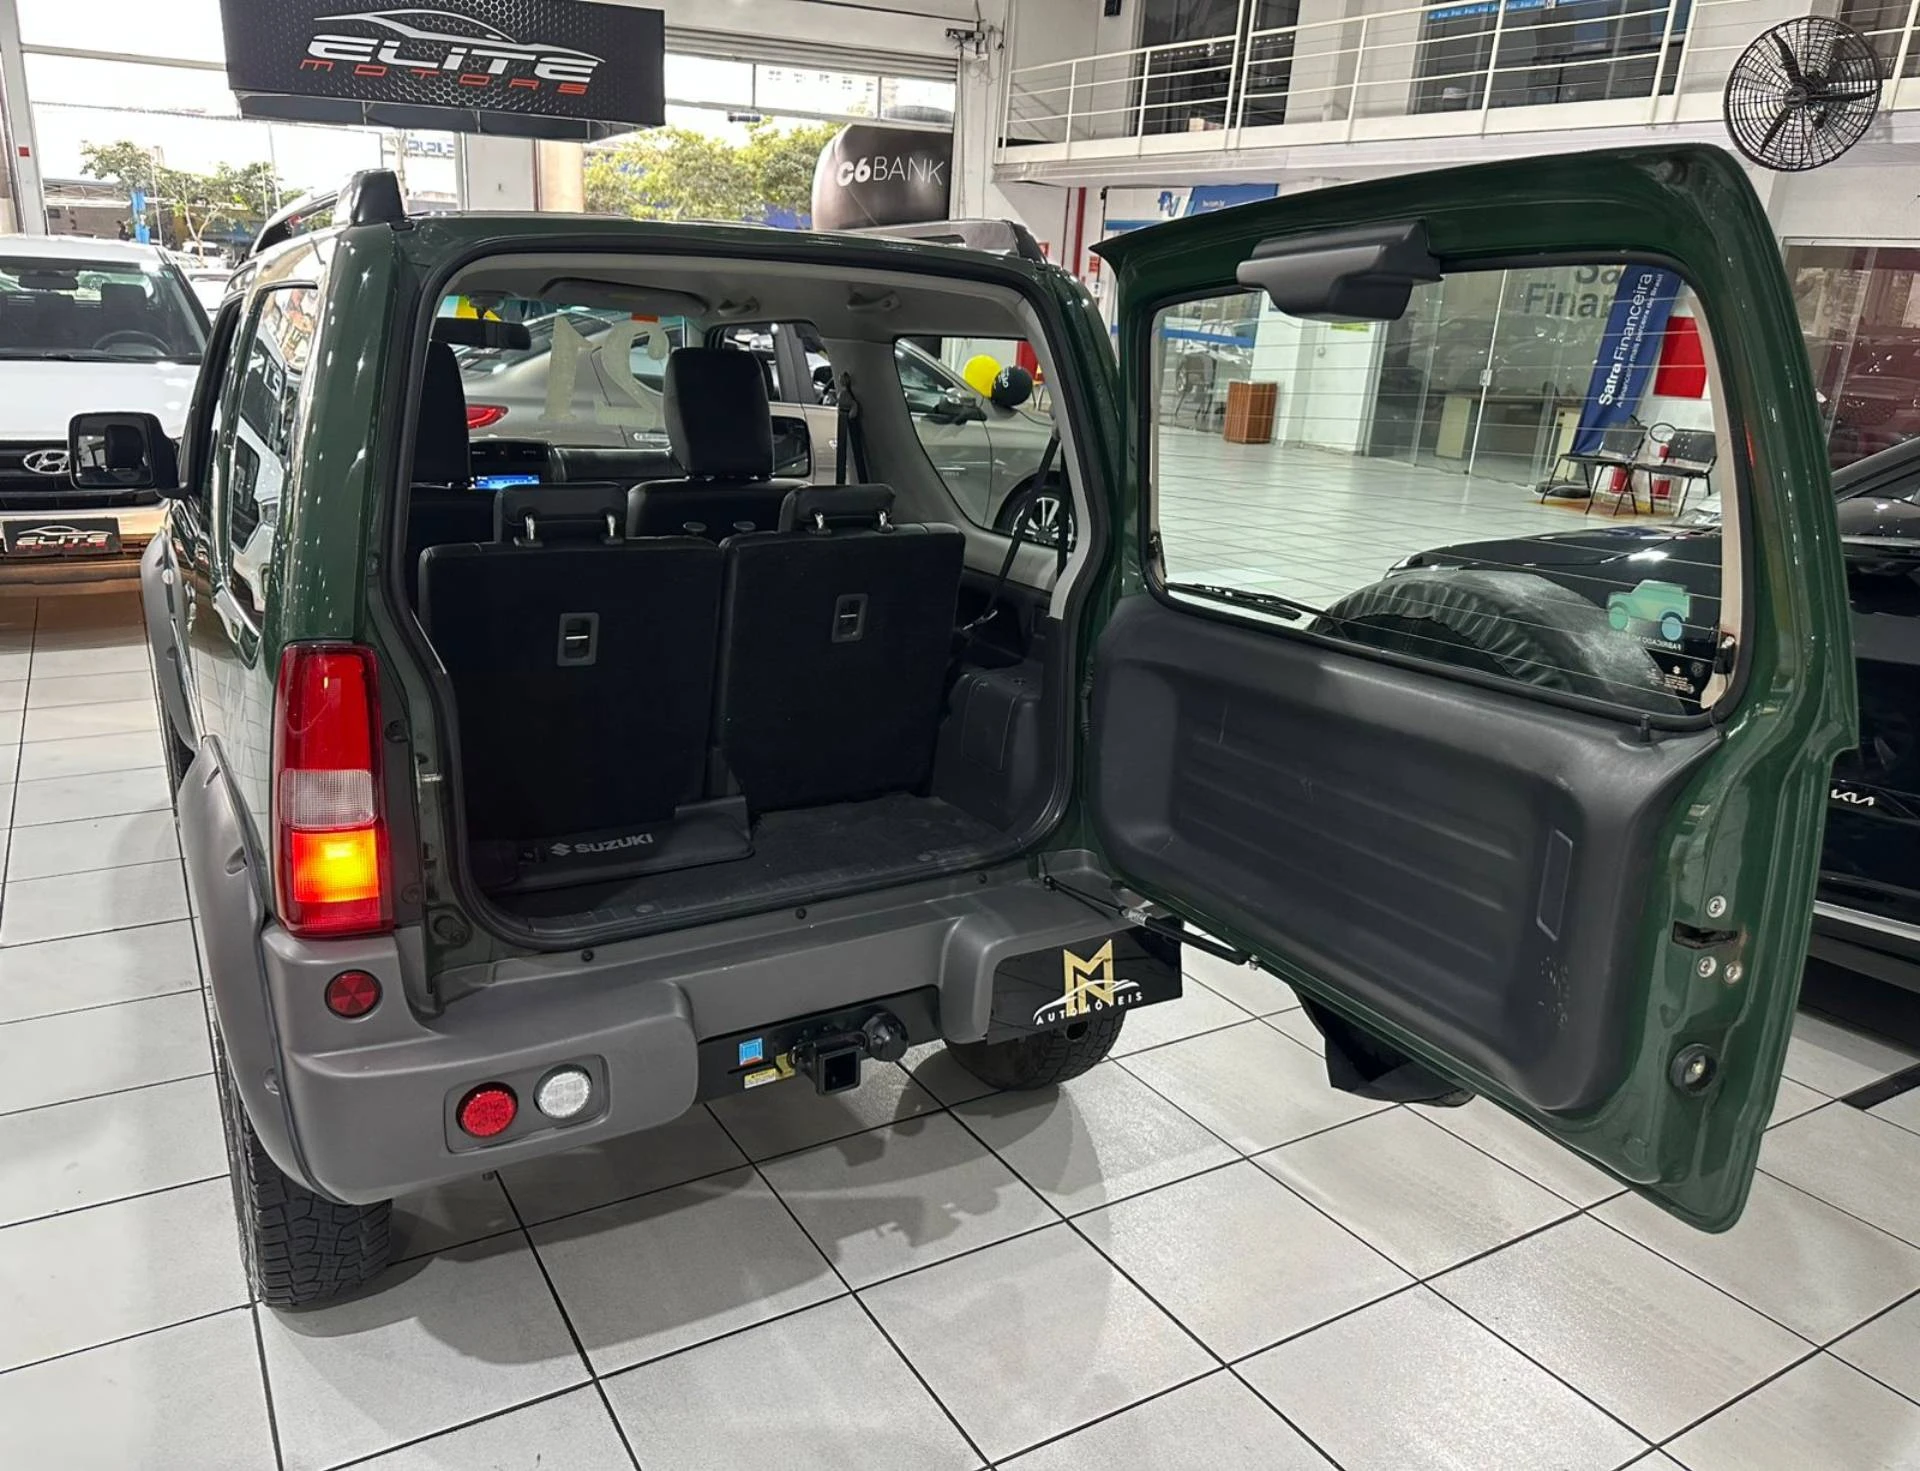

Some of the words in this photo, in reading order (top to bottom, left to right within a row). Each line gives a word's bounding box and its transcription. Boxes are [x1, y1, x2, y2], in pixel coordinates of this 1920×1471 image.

[299, 58, 589, 97] MOTORS
[306, 34, 599, 84] ELITE
[1598, 363, 1622, 405] Safra
[1613, 273, 1653, 361] Financeira
[1629, 342, 1640, 361] mais
[1650, 273, 1664, 296] Brasil
[575, 833, 654, 854] SUZUKI
